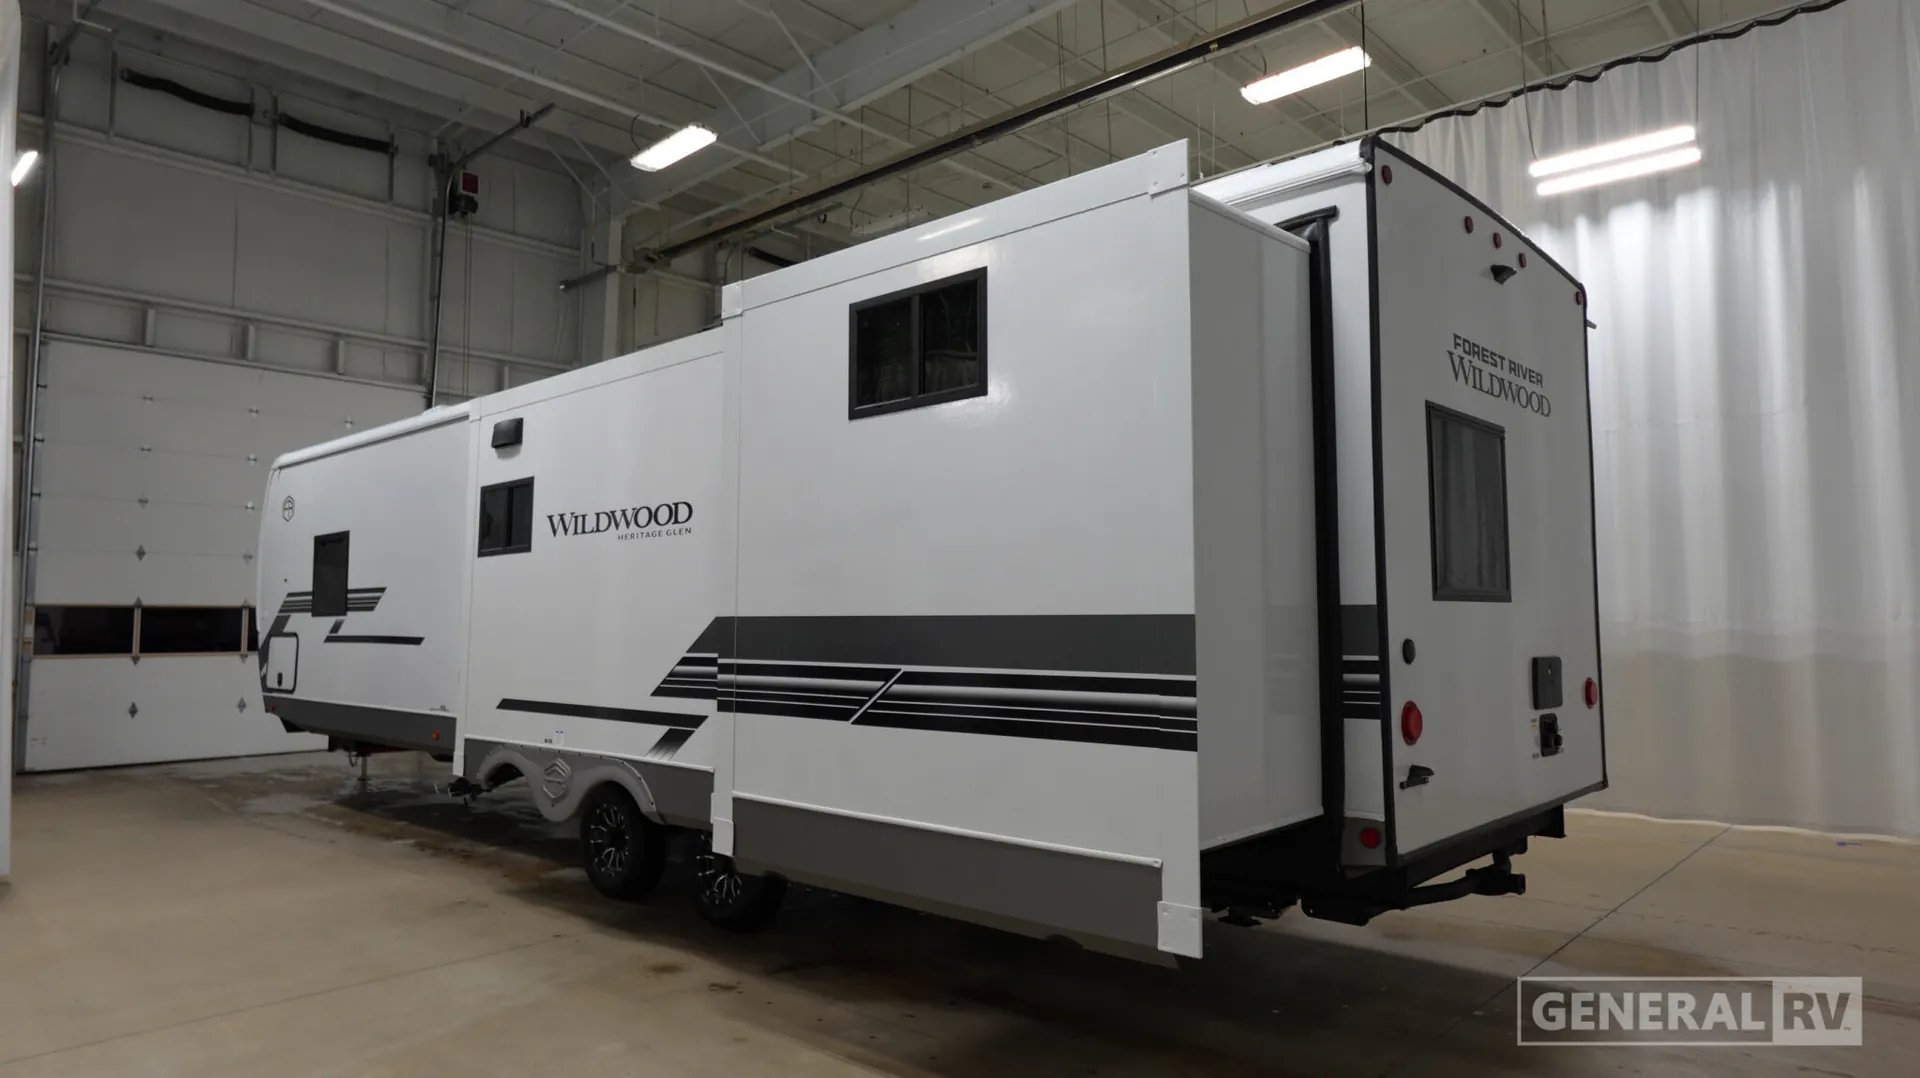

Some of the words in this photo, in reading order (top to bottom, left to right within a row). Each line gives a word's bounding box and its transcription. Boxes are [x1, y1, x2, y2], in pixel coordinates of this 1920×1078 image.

[1446, 349, 1551, 418] WILDWOOD
[1453, 333, 1506, 371] FOREST
[1508, 358, 1544, 388] RIVER
[546, 501, 693, 538] WILDWOOD
[617, 529, 663, 541] HERITAGE
[665, 527, 692, 537] GLEN
